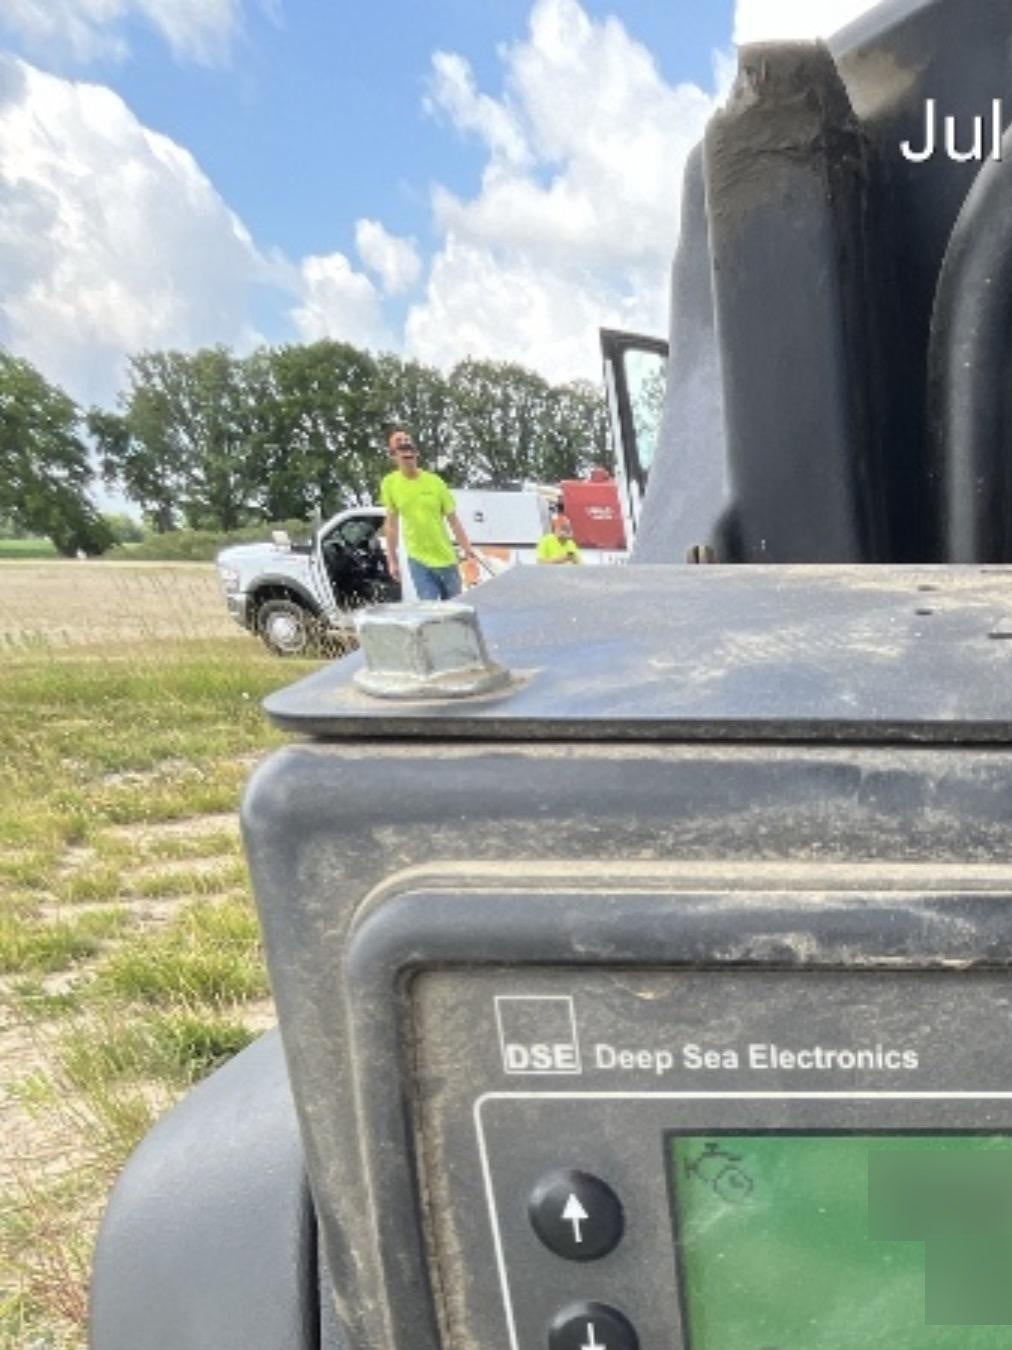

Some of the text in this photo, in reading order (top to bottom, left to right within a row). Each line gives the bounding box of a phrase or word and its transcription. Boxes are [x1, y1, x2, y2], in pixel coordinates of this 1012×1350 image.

[505, 1043, 576, 1070] DSE
[595, 1043, 919, 1074] Deep Sea Electronics
